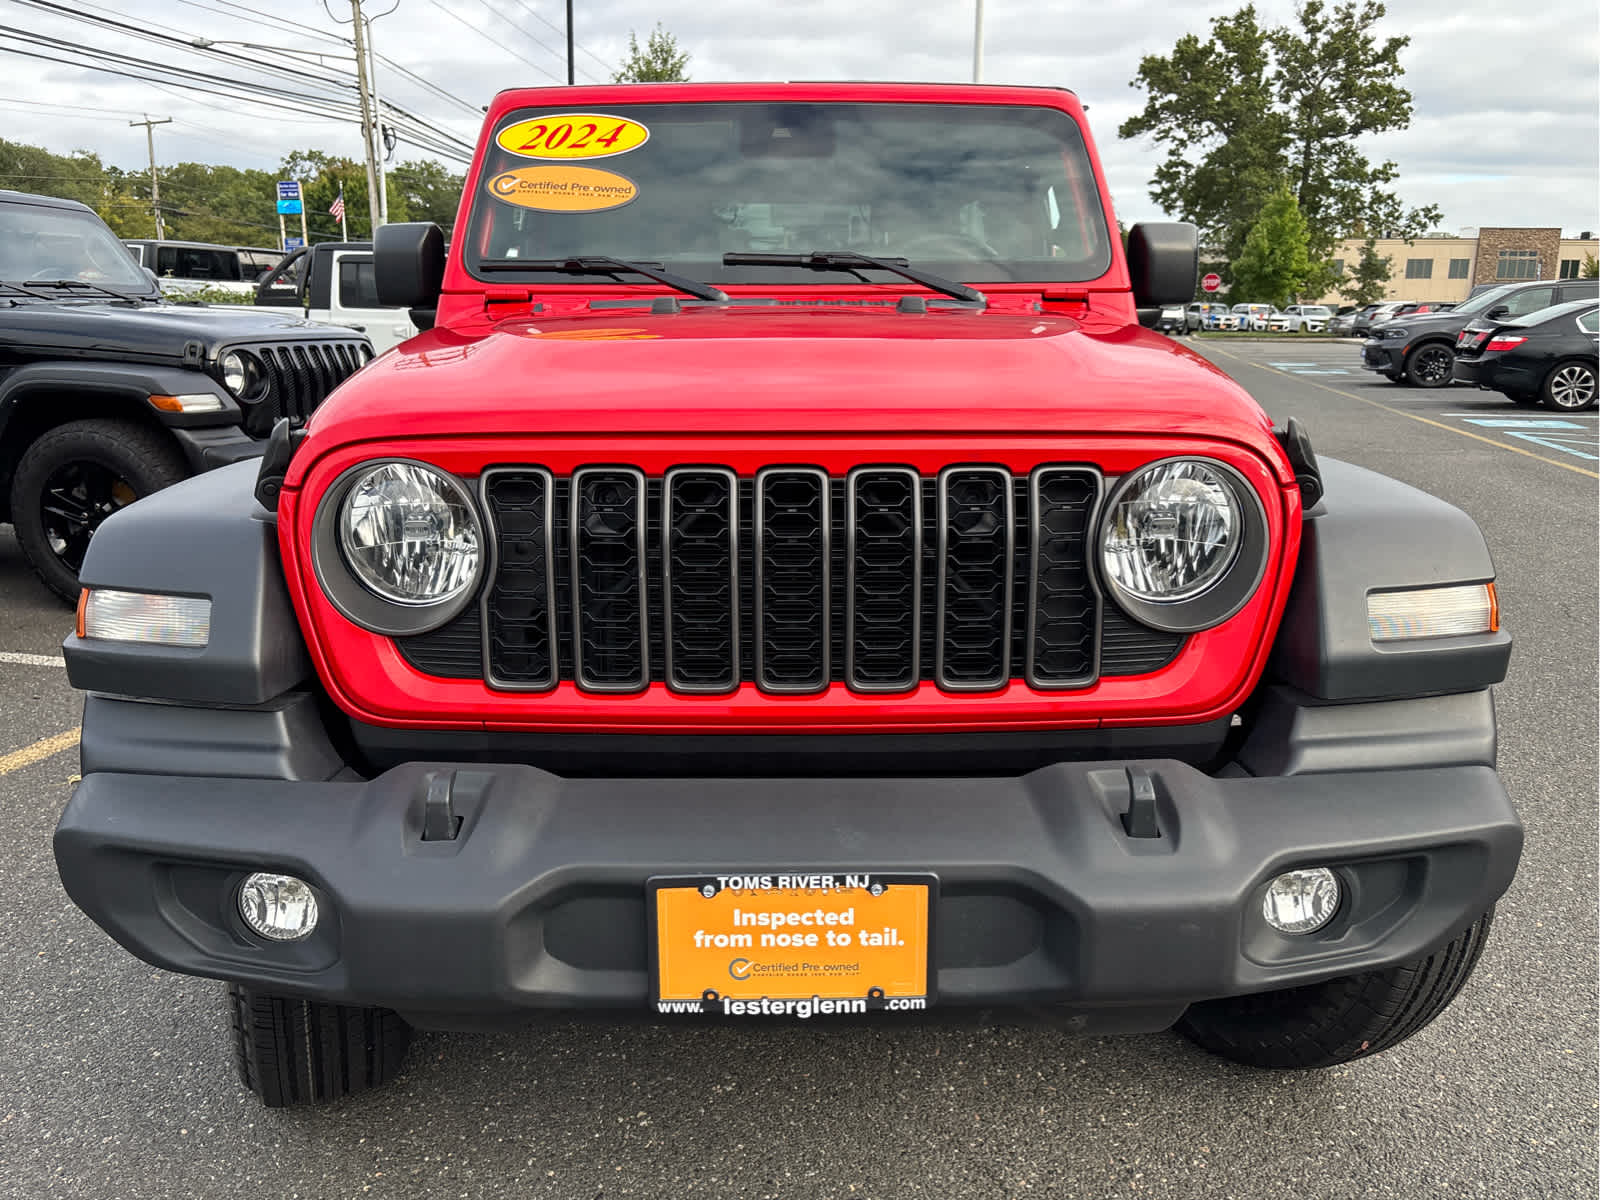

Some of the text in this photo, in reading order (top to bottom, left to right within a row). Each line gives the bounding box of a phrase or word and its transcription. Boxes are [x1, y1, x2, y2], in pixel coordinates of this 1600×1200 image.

[517, 123, 627, 150] 2024
[519, 180, 568, 191] Certified
[1201, 278, 1220, 287] STOP
[717, 874, 869, 890] TOMS RIVER, NJ
[733, 908, 854, 930] Inspected
[693, 928, 905, 948] from nose to tail.
[752, 963, 798, 973] Certified
[657, 998, 926, 1018] www. lesterglenn .com
